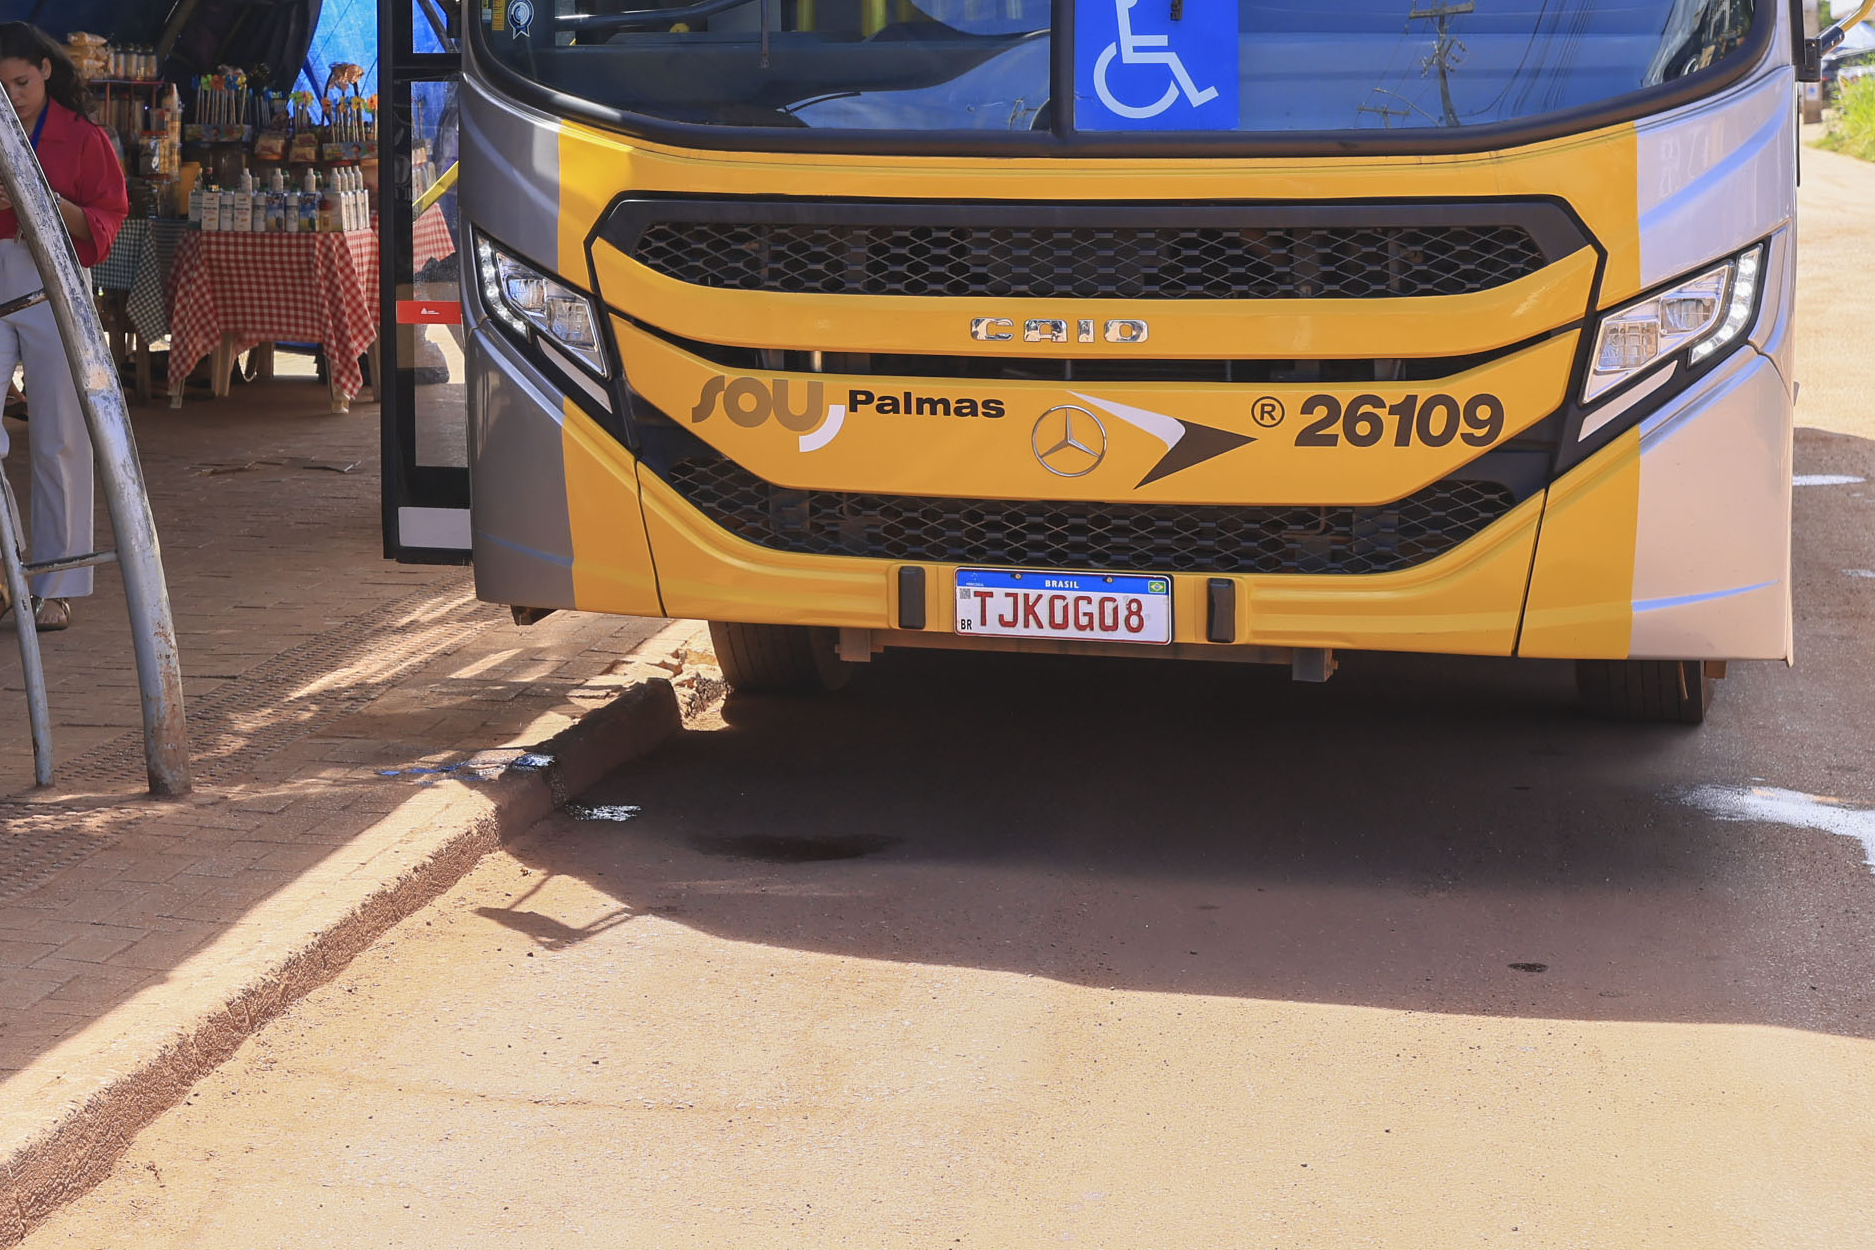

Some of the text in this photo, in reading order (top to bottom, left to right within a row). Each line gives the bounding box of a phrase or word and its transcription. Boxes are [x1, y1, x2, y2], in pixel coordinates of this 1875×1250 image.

[971, 317, 1149, 343] CAIO
[848, 389, 1006, 419] Palmas
[1294, 393, 1505, 448] 26109
[1044, 579, 1080, 589] BRASIL
[960, 618, 973, 631] BR
